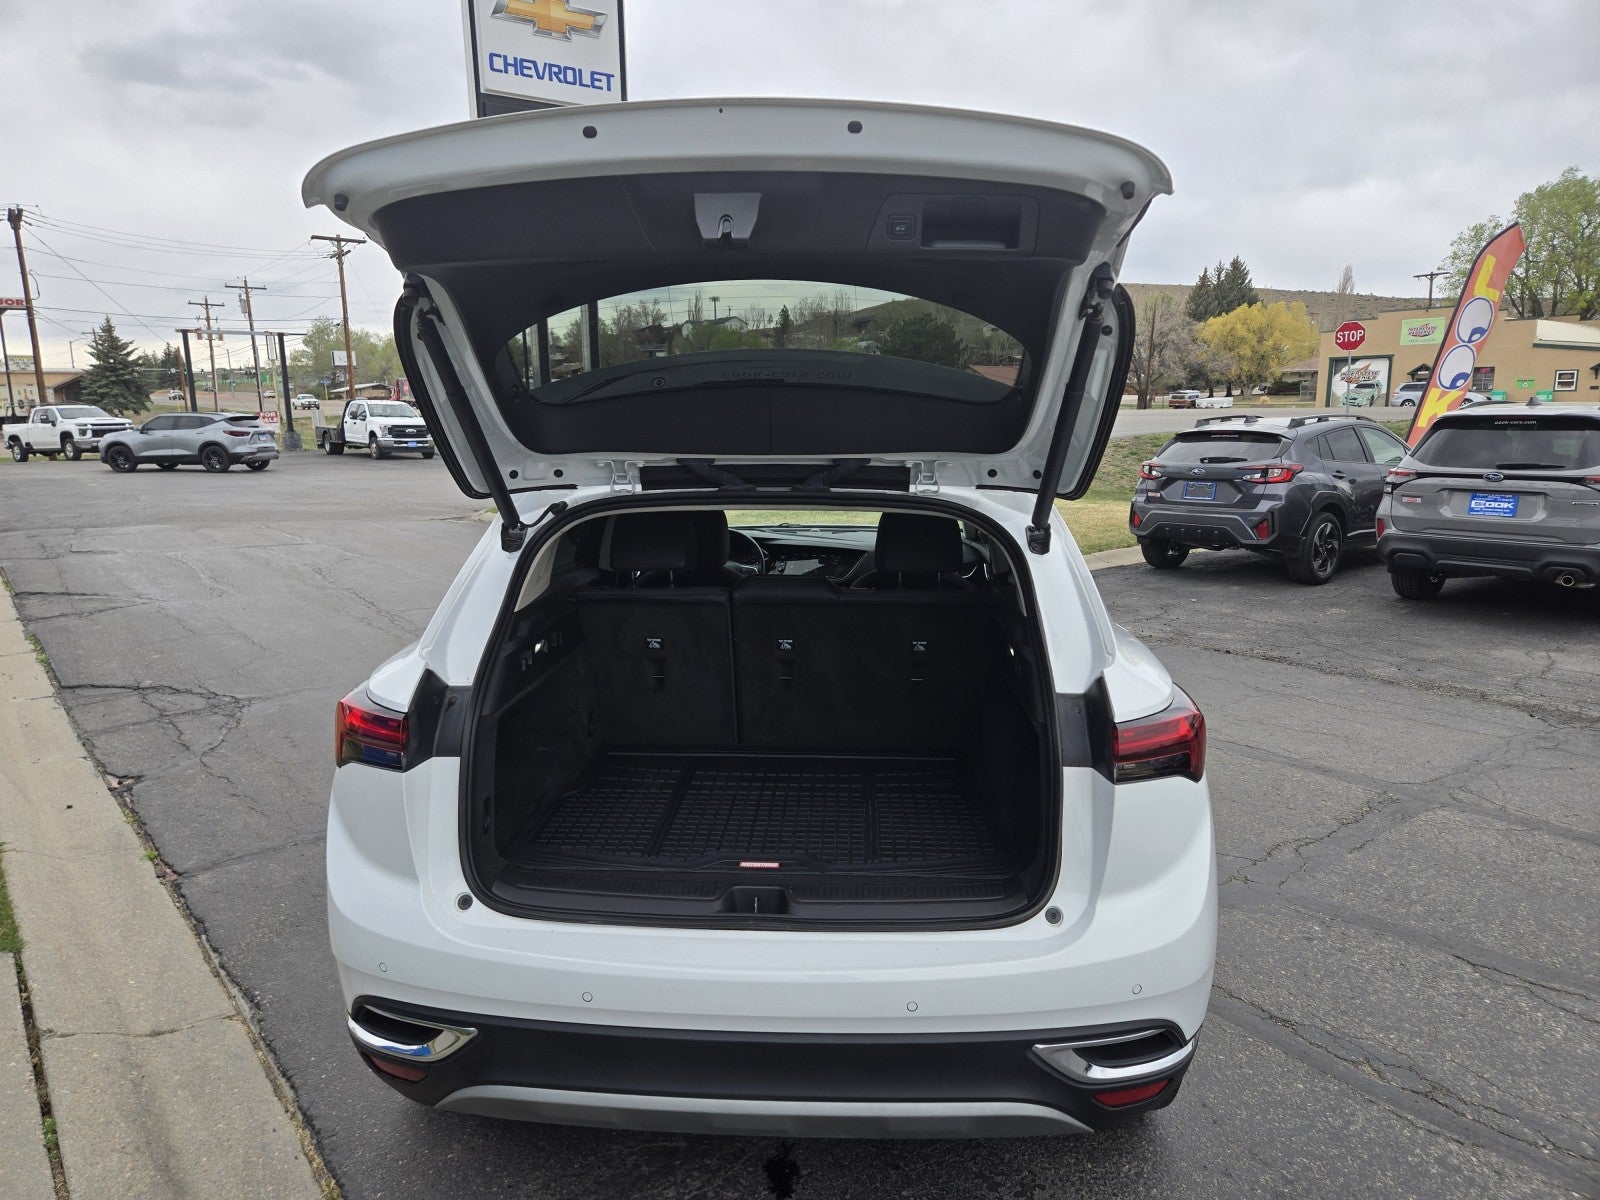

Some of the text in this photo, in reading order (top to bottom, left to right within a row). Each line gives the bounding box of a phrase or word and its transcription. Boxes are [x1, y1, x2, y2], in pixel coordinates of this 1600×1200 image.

[488, 52, 615, 91] CHEVROLET
[1336, 330, 1364, 343] STOP
[1471, 500, 1514, 509] COOK
